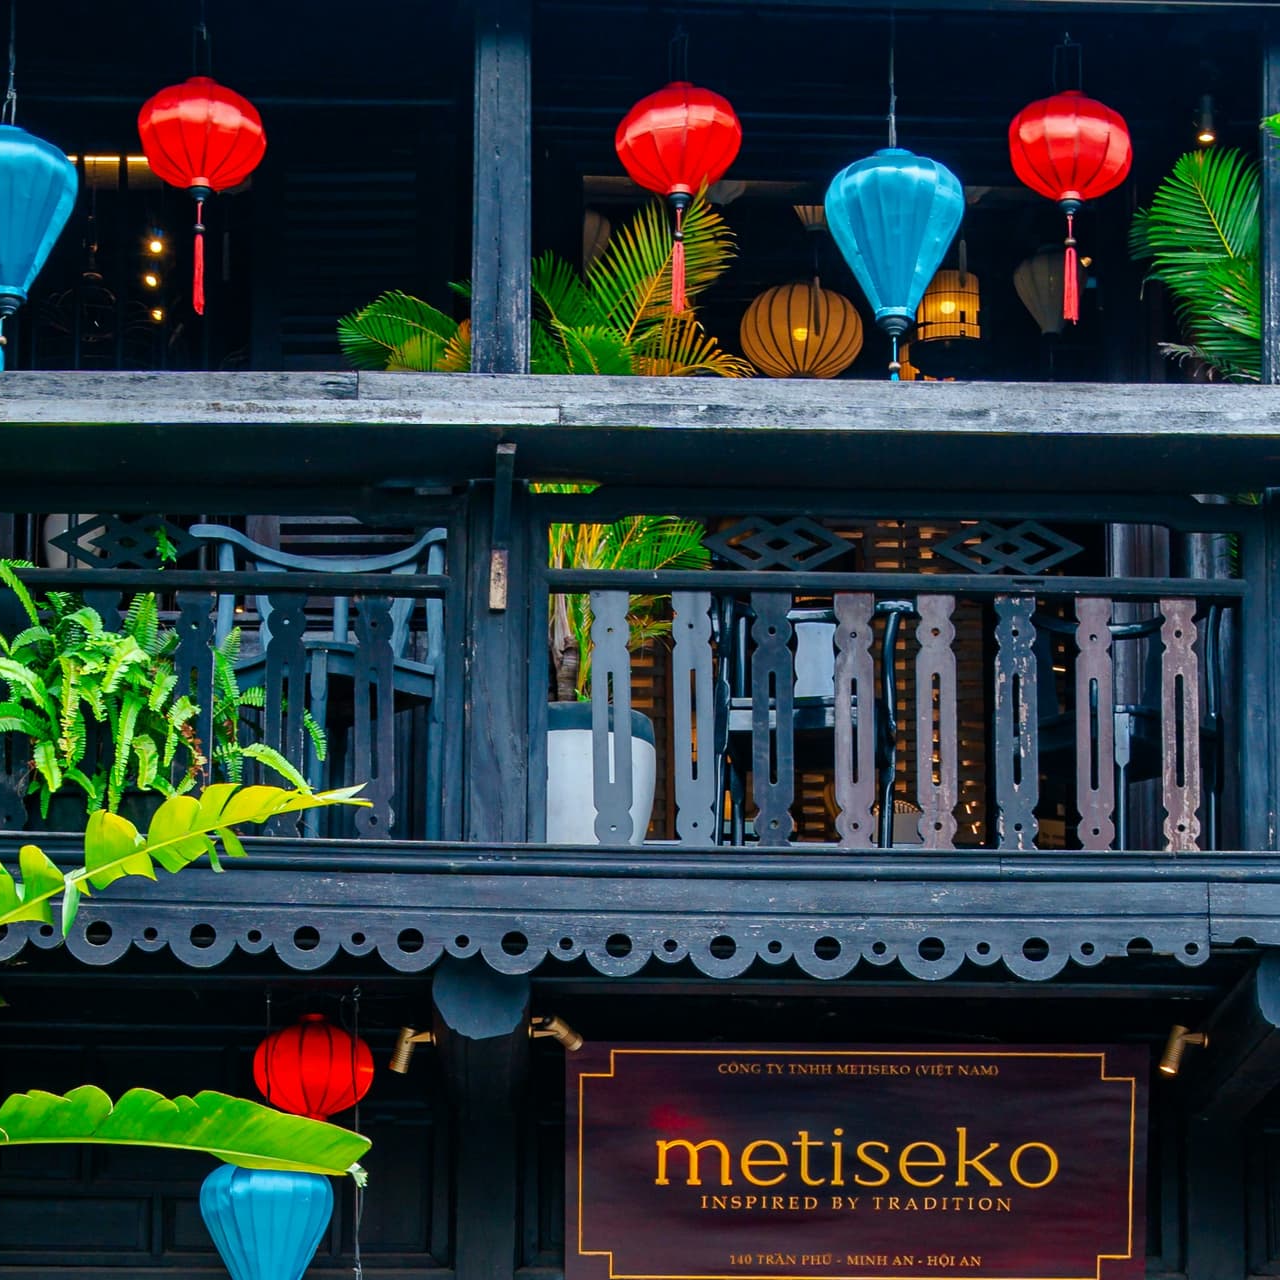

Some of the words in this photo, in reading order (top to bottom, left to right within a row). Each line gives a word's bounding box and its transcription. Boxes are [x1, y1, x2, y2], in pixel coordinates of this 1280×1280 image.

[718, 1061, 761, 1074] CÔNG
[766, 1064, 784, 1074] TY
[788, 1064, 832, 1075] TNHH
[836, 1064, 911, 1075] METISEKO
[958, 1065, 999, 1076] NAM)
[655, 1127, 1059, 1189] metiseko
[701, 1195, 819, 1211] INSPIRED
[831, 1196, 859, 1211] BY
[873, 1196, 1012, 1212] TRADITION
[729, 1254, 753, 1265] 140
[846, 1255, 888, 1266] MINH
[892, 1255, 914, 1266] AN
[927, 1253, 955, 1268] HỘI
[959, 1255, 982, 1266] AN
